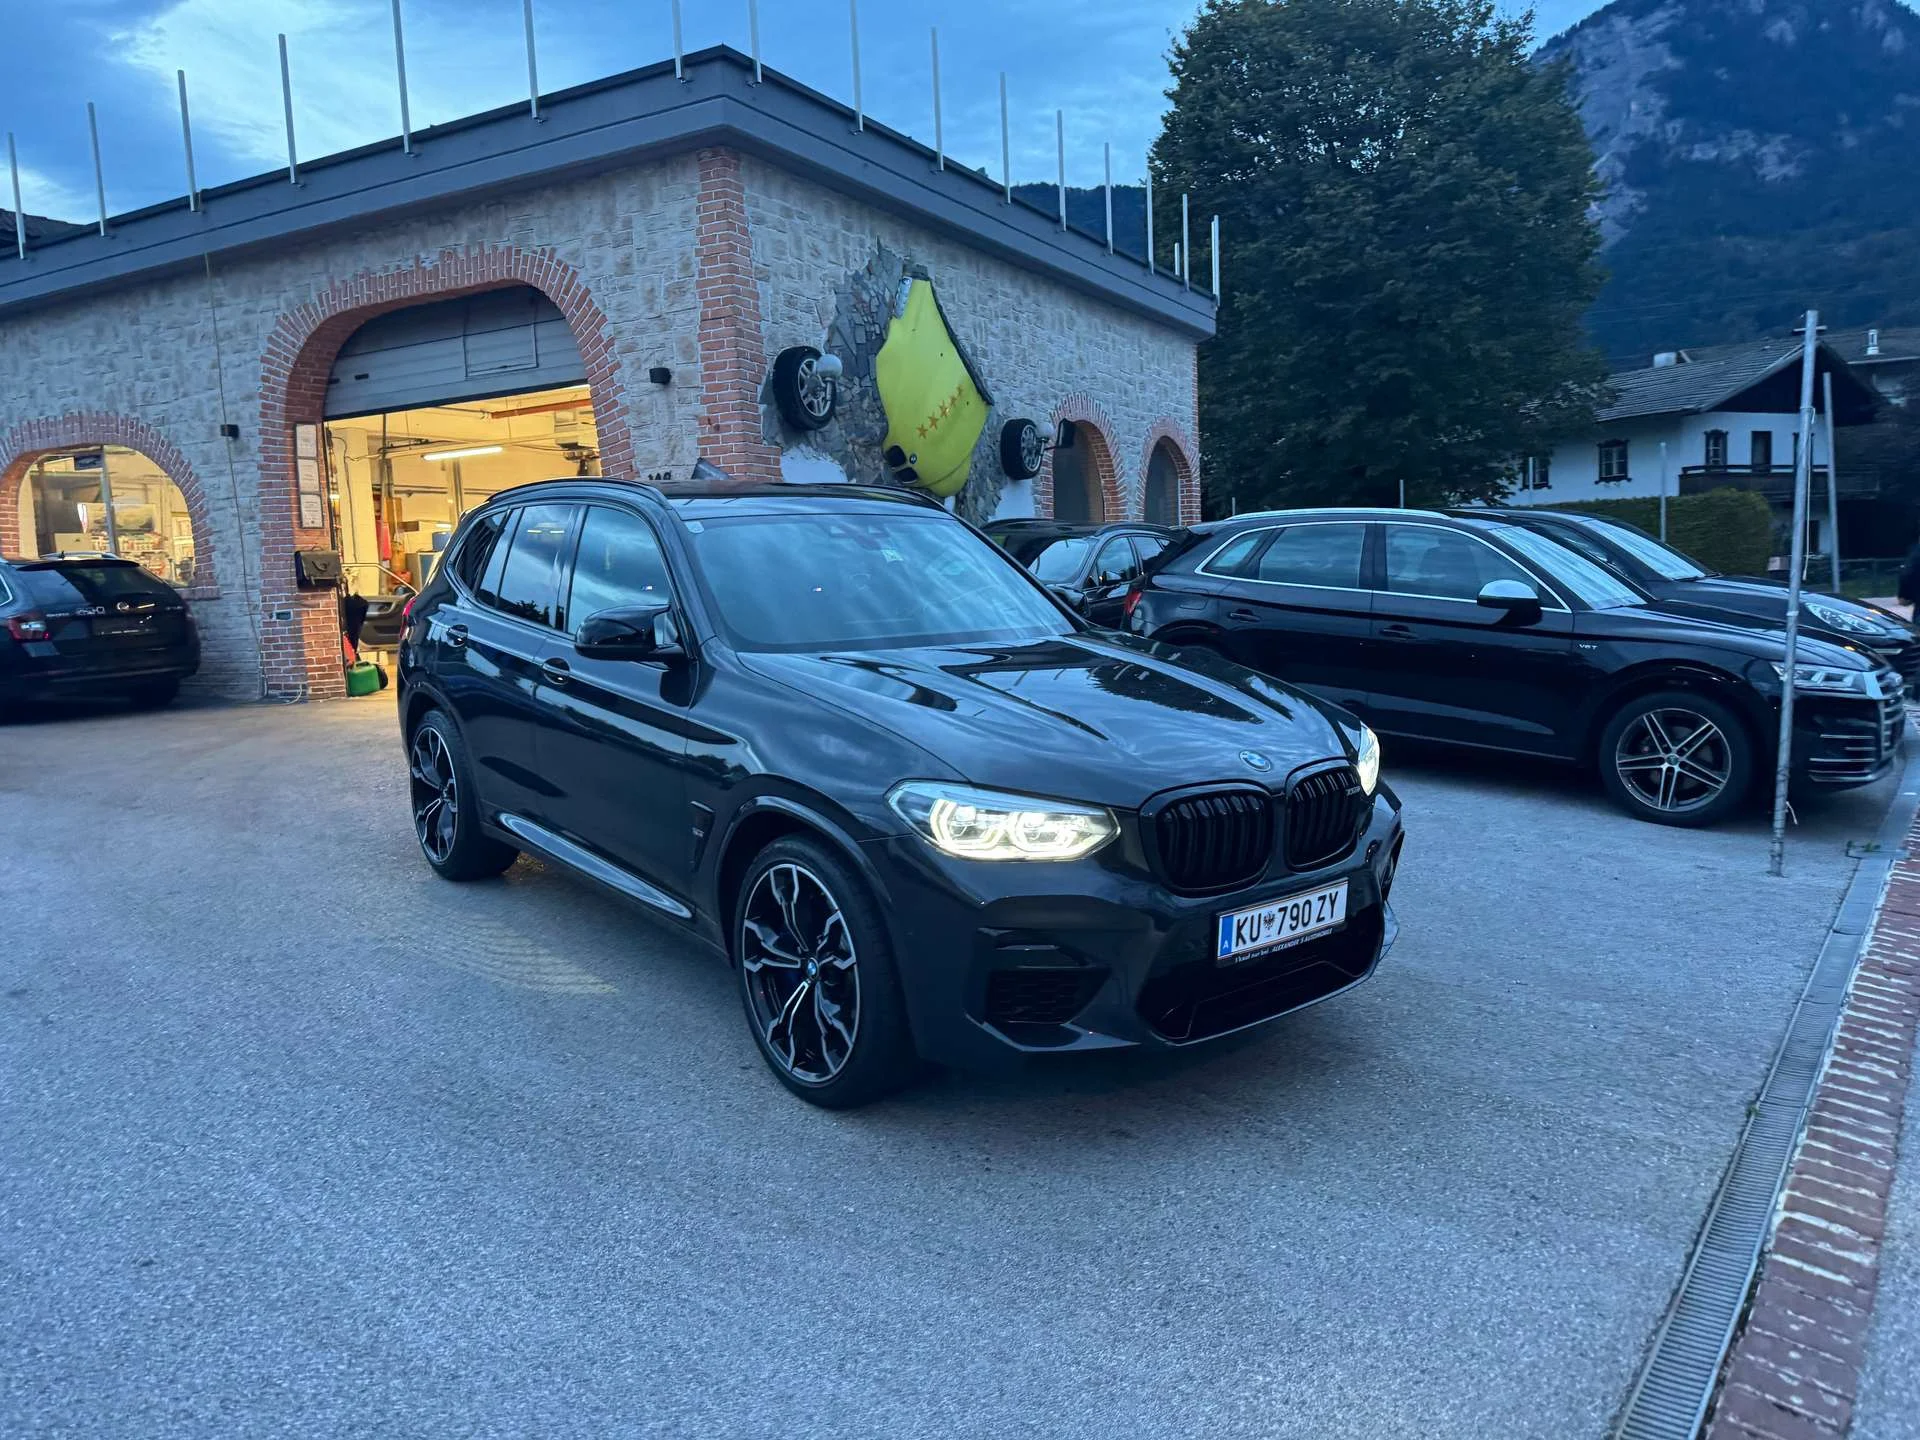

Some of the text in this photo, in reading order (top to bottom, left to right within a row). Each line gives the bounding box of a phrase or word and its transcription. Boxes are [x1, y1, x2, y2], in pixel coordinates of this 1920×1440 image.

[1235, 912, 1262, 948] KU
[1277, 899, 1312, 935] 790
[1222, 940, 1229, 949] A
